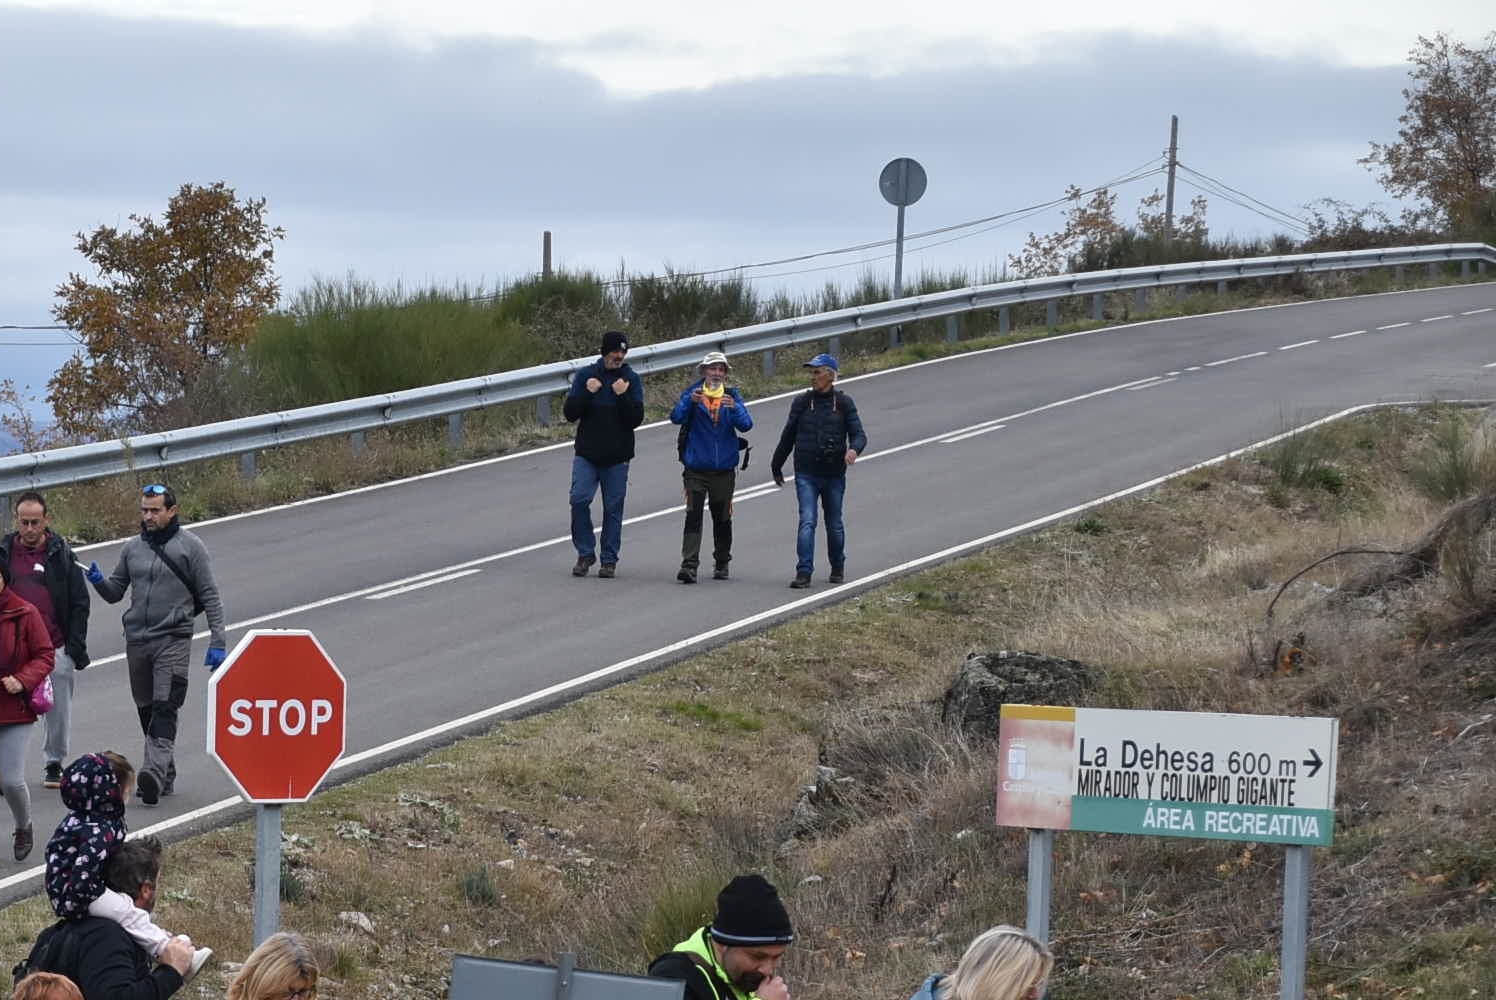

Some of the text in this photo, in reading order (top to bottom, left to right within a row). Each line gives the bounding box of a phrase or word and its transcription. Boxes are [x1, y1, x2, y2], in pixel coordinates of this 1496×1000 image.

[227, 698, 333, 736] STOP
[1079, 737, 1297, 777] La Dehesa 600 m
[1077, 768, 1140, 800] MIRADOR
[1146, 772, 1155, 801] Y
[1160, 772, 1231, 804] COLUMPIO
[1236, 775, 1297, 808] GIGANTE
[1142, 801, 1321, 839] ÁREA RECREATIVA
